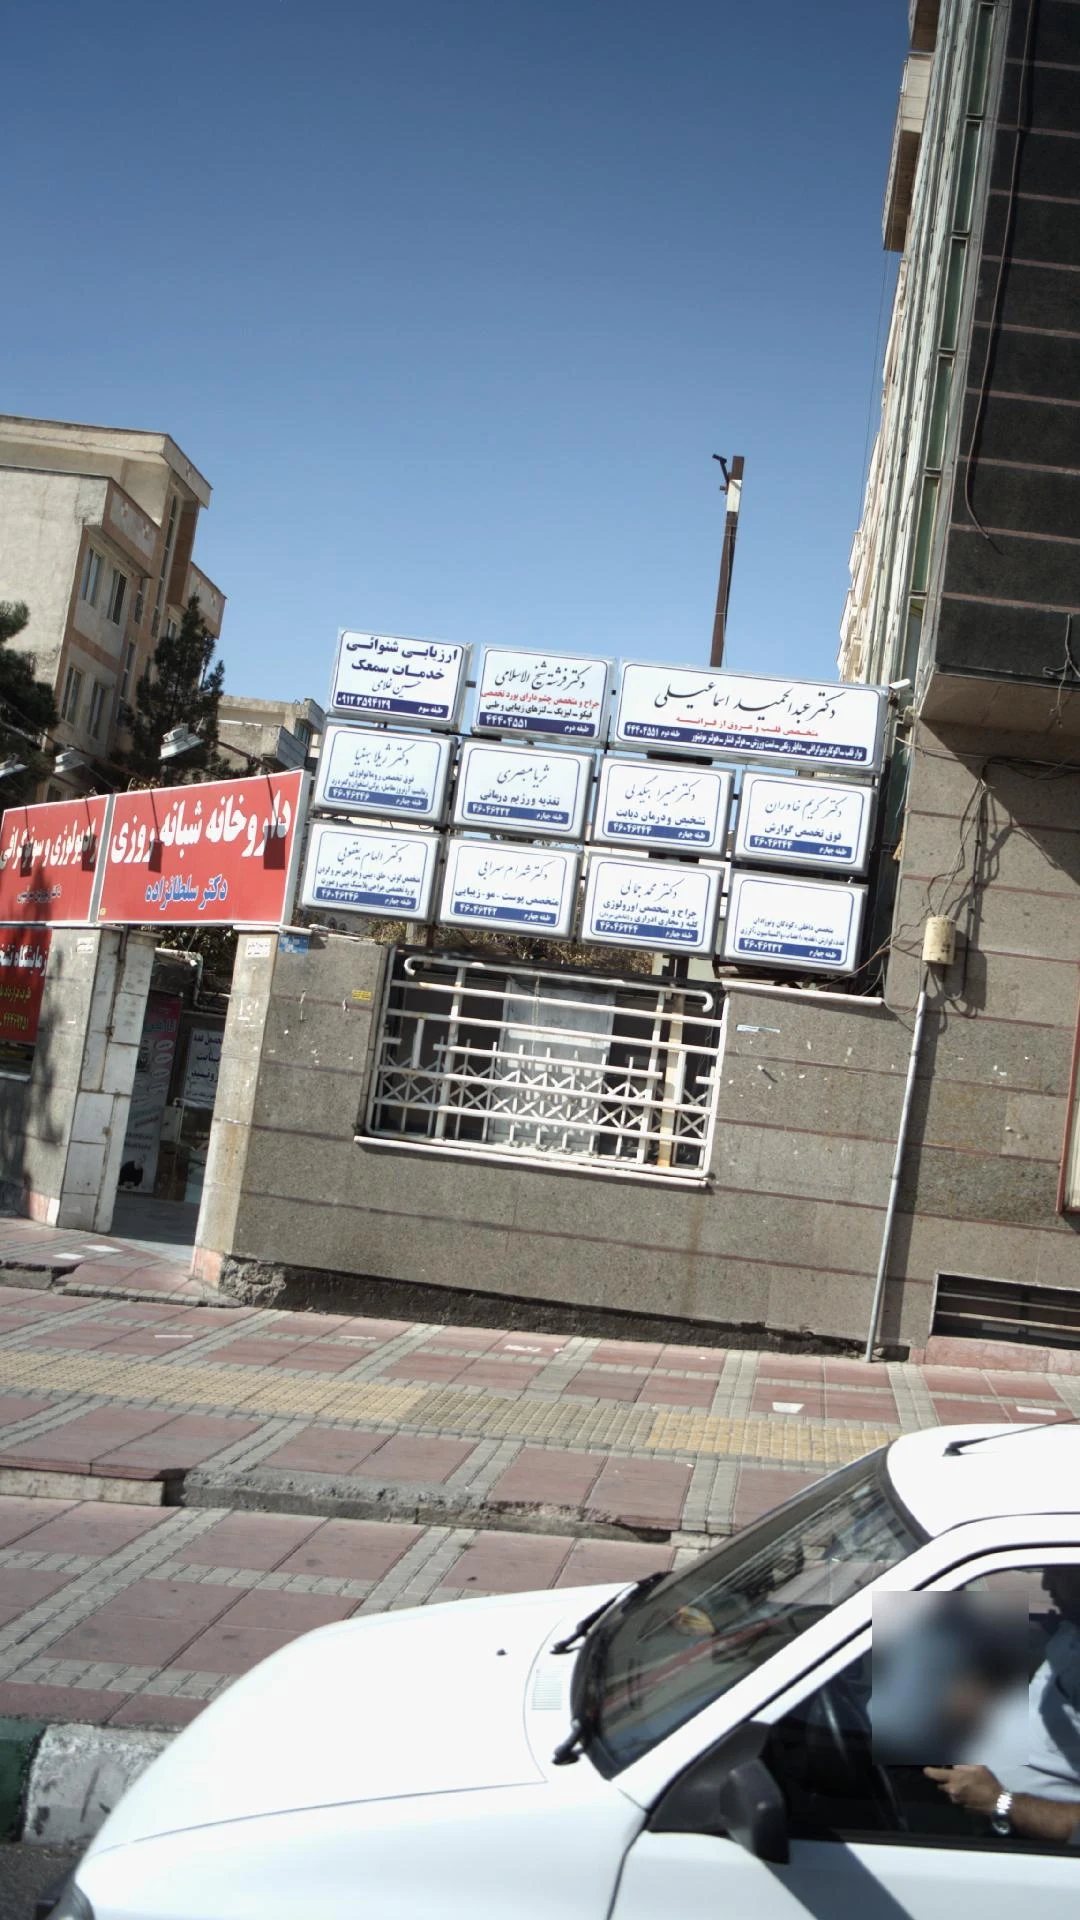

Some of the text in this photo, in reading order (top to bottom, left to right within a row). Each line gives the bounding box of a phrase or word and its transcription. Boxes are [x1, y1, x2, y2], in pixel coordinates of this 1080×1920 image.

[346, 637, 458, 663] ارزیابی شنوائی
[352, 659, 445, 679] خدمات سمعک
[495, 661, 592, 690] دکتر فرشته شیخ الاسلامی
[372, 679, 421, 697] حسین غلامی
[507, 692, 518, 700] بورد
[520, 693, 537, 701] دارای
[418, 705, 429, 713] سوم
[486, 700, 499, 709] طبی
[506, 703, 524, 713] زیبایی
[584, 700, 600, 709] جراح
[806, 691, 846, 721] دکتر
[430, 706, 443, 715] طبقه
[526, 705, 546, 715] لنزهای
[554, 708, 571, 717] لیزیک
[580, 711, 592, 720] فیکو
[486, 714, 527, 728] ۴۴۴۰۴۵۵۱
[676, 715, 717, 727] فرانسه
[720, 720, 726, 728] از
[728, 722, 753, 730] عروق
[564, 724, 575, 732] دوم
[387, 743, 416, 768] دکتر
[845, 748, 853, 757] قلب
[854, 750, 863, 760] نوار
[404, 776, 414, 784] فوق
[533, 765, 550, 788] ثریا
[675, 779, 702, 803] دکتر
[396, 797, 410, 806] چهارم
[480, 789, 560, 806] تغذیه درمانی
[765, 796, 848, 821] دکتر کریم خاوران
[536, 812, 551, 820] چهارم
[616, 808, 705, 826] تشخیص دیابت
[111, 789, 291, 864] داروخانه شبانه روزی
[678, 830, 693, 839] چهارم
[765, 822, 841, 842] فوق تخصص گوارش
[43, 834, 51, 867] و
[383, 844, 409, 865] دکتر
[819, 846, 834, 855] چهارم
[530, 860, 556, 882] دکتر
[198, 874, 228, 910] دکتر
[655, 877, 685, 902] دکتر
[385, 897, 398, 905] چهارم
[455, 887, 559, 906] متخصص پوست مو زیبایی
[603, 900, 638, 913] اورولوژی
[640, 906, 669, 914] متخصص
[524, 913, 538, 921] چهارم
[677, 908, 696, 919] جراح
[635, 915, 656, 923] ادراری
[686, 920, 698, 928] کلیه
[665, 929, 680, 938] چهارم
[809, 950, 824, 958] چهارم
[13, 943, 47, 976] زمایشگاه
